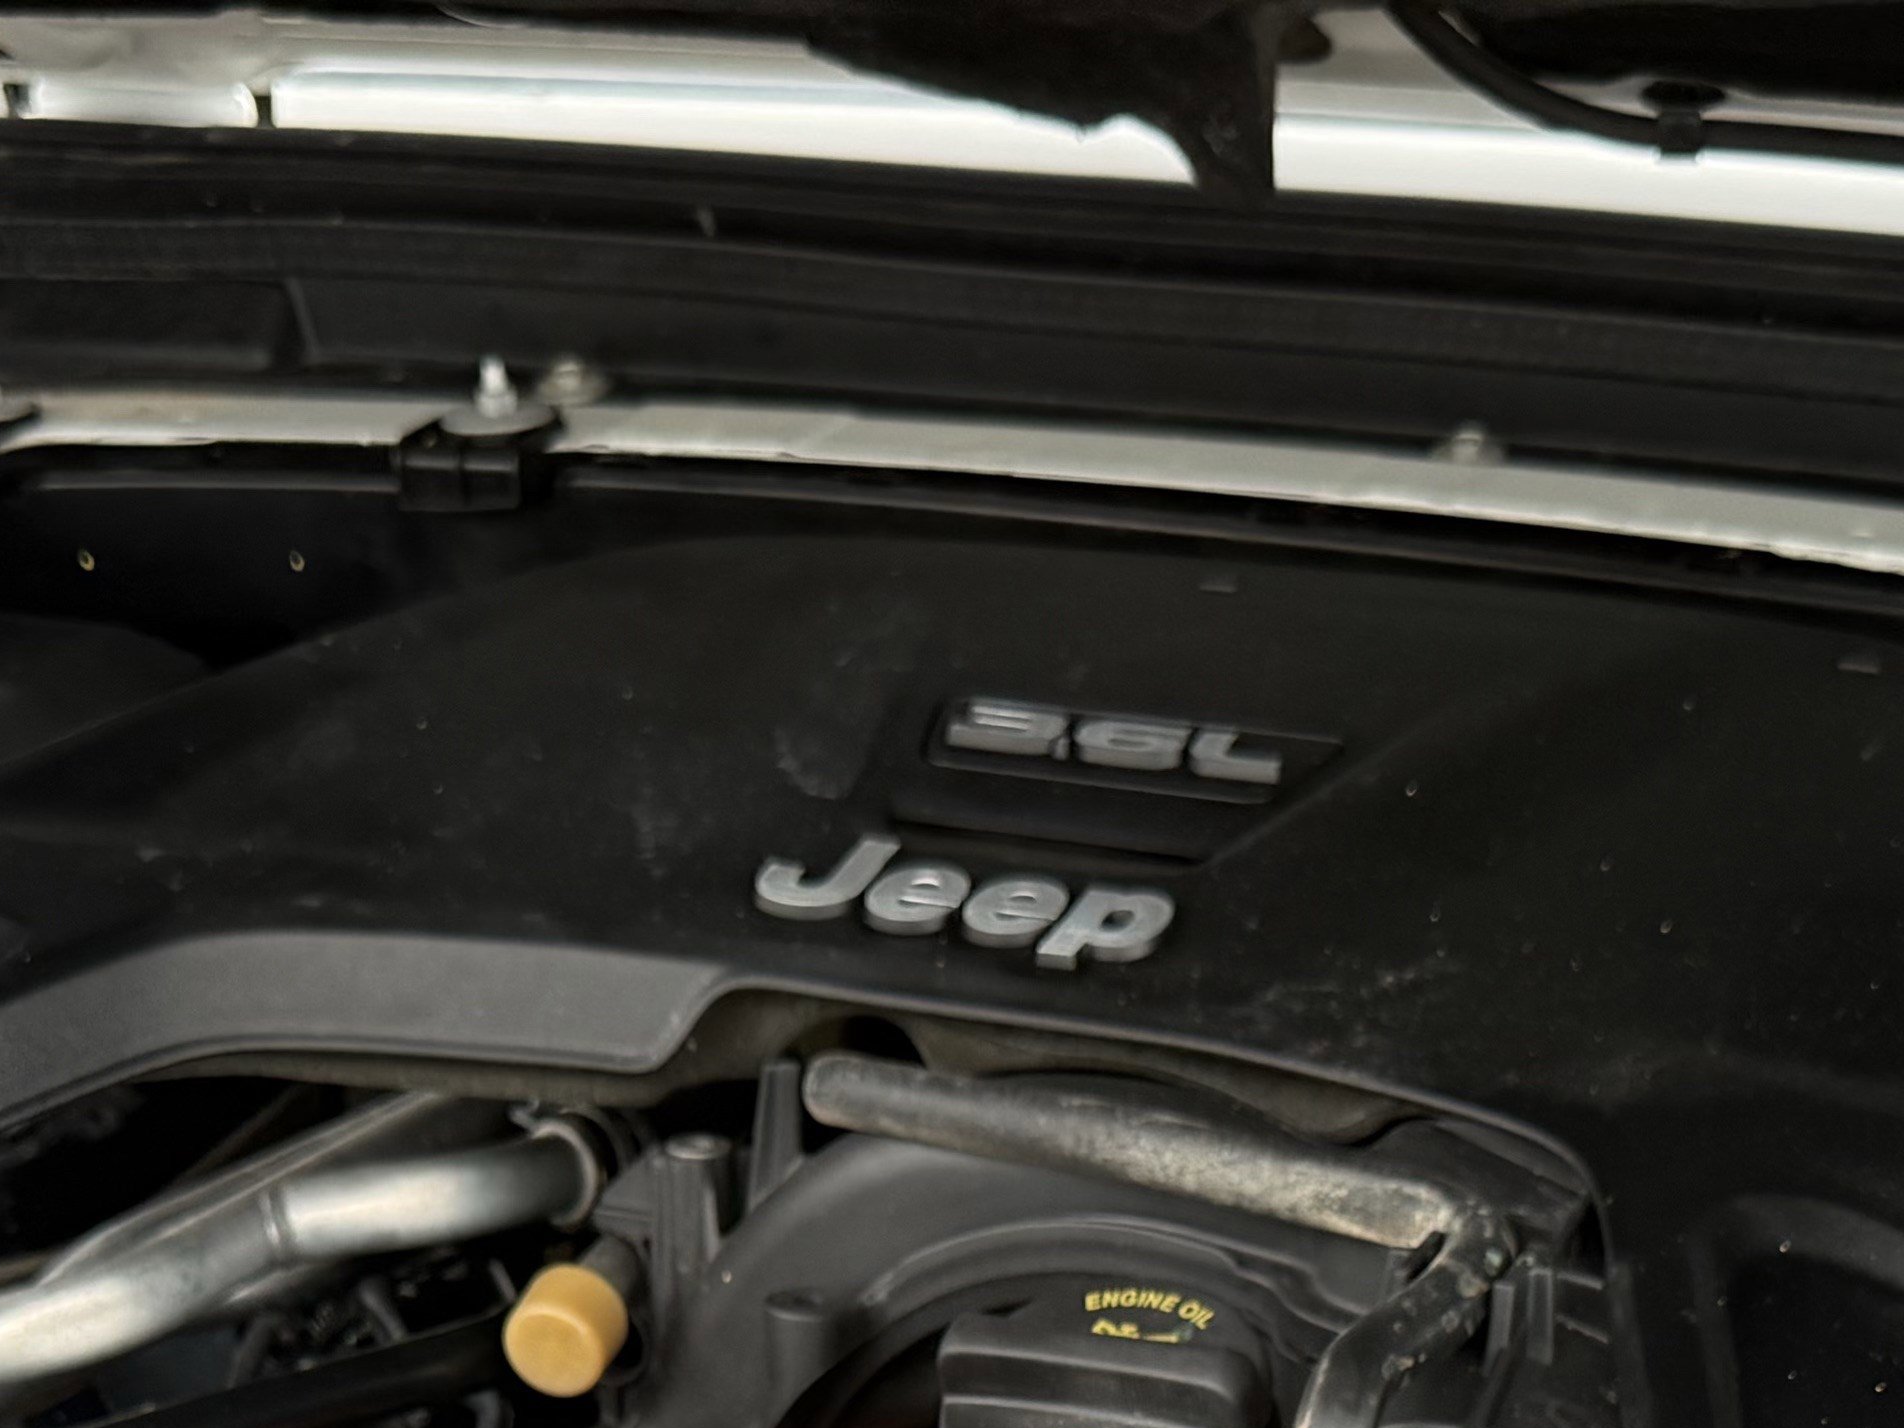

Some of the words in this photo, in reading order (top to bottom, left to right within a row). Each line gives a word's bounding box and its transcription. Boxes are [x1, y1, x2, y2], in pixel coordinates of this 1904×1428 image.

[755, 834, 1175, 971] Jeep
[1084, 1289, 1179, 1313] ENGINE
[1177, 1299, 1215, 1331] OIL
